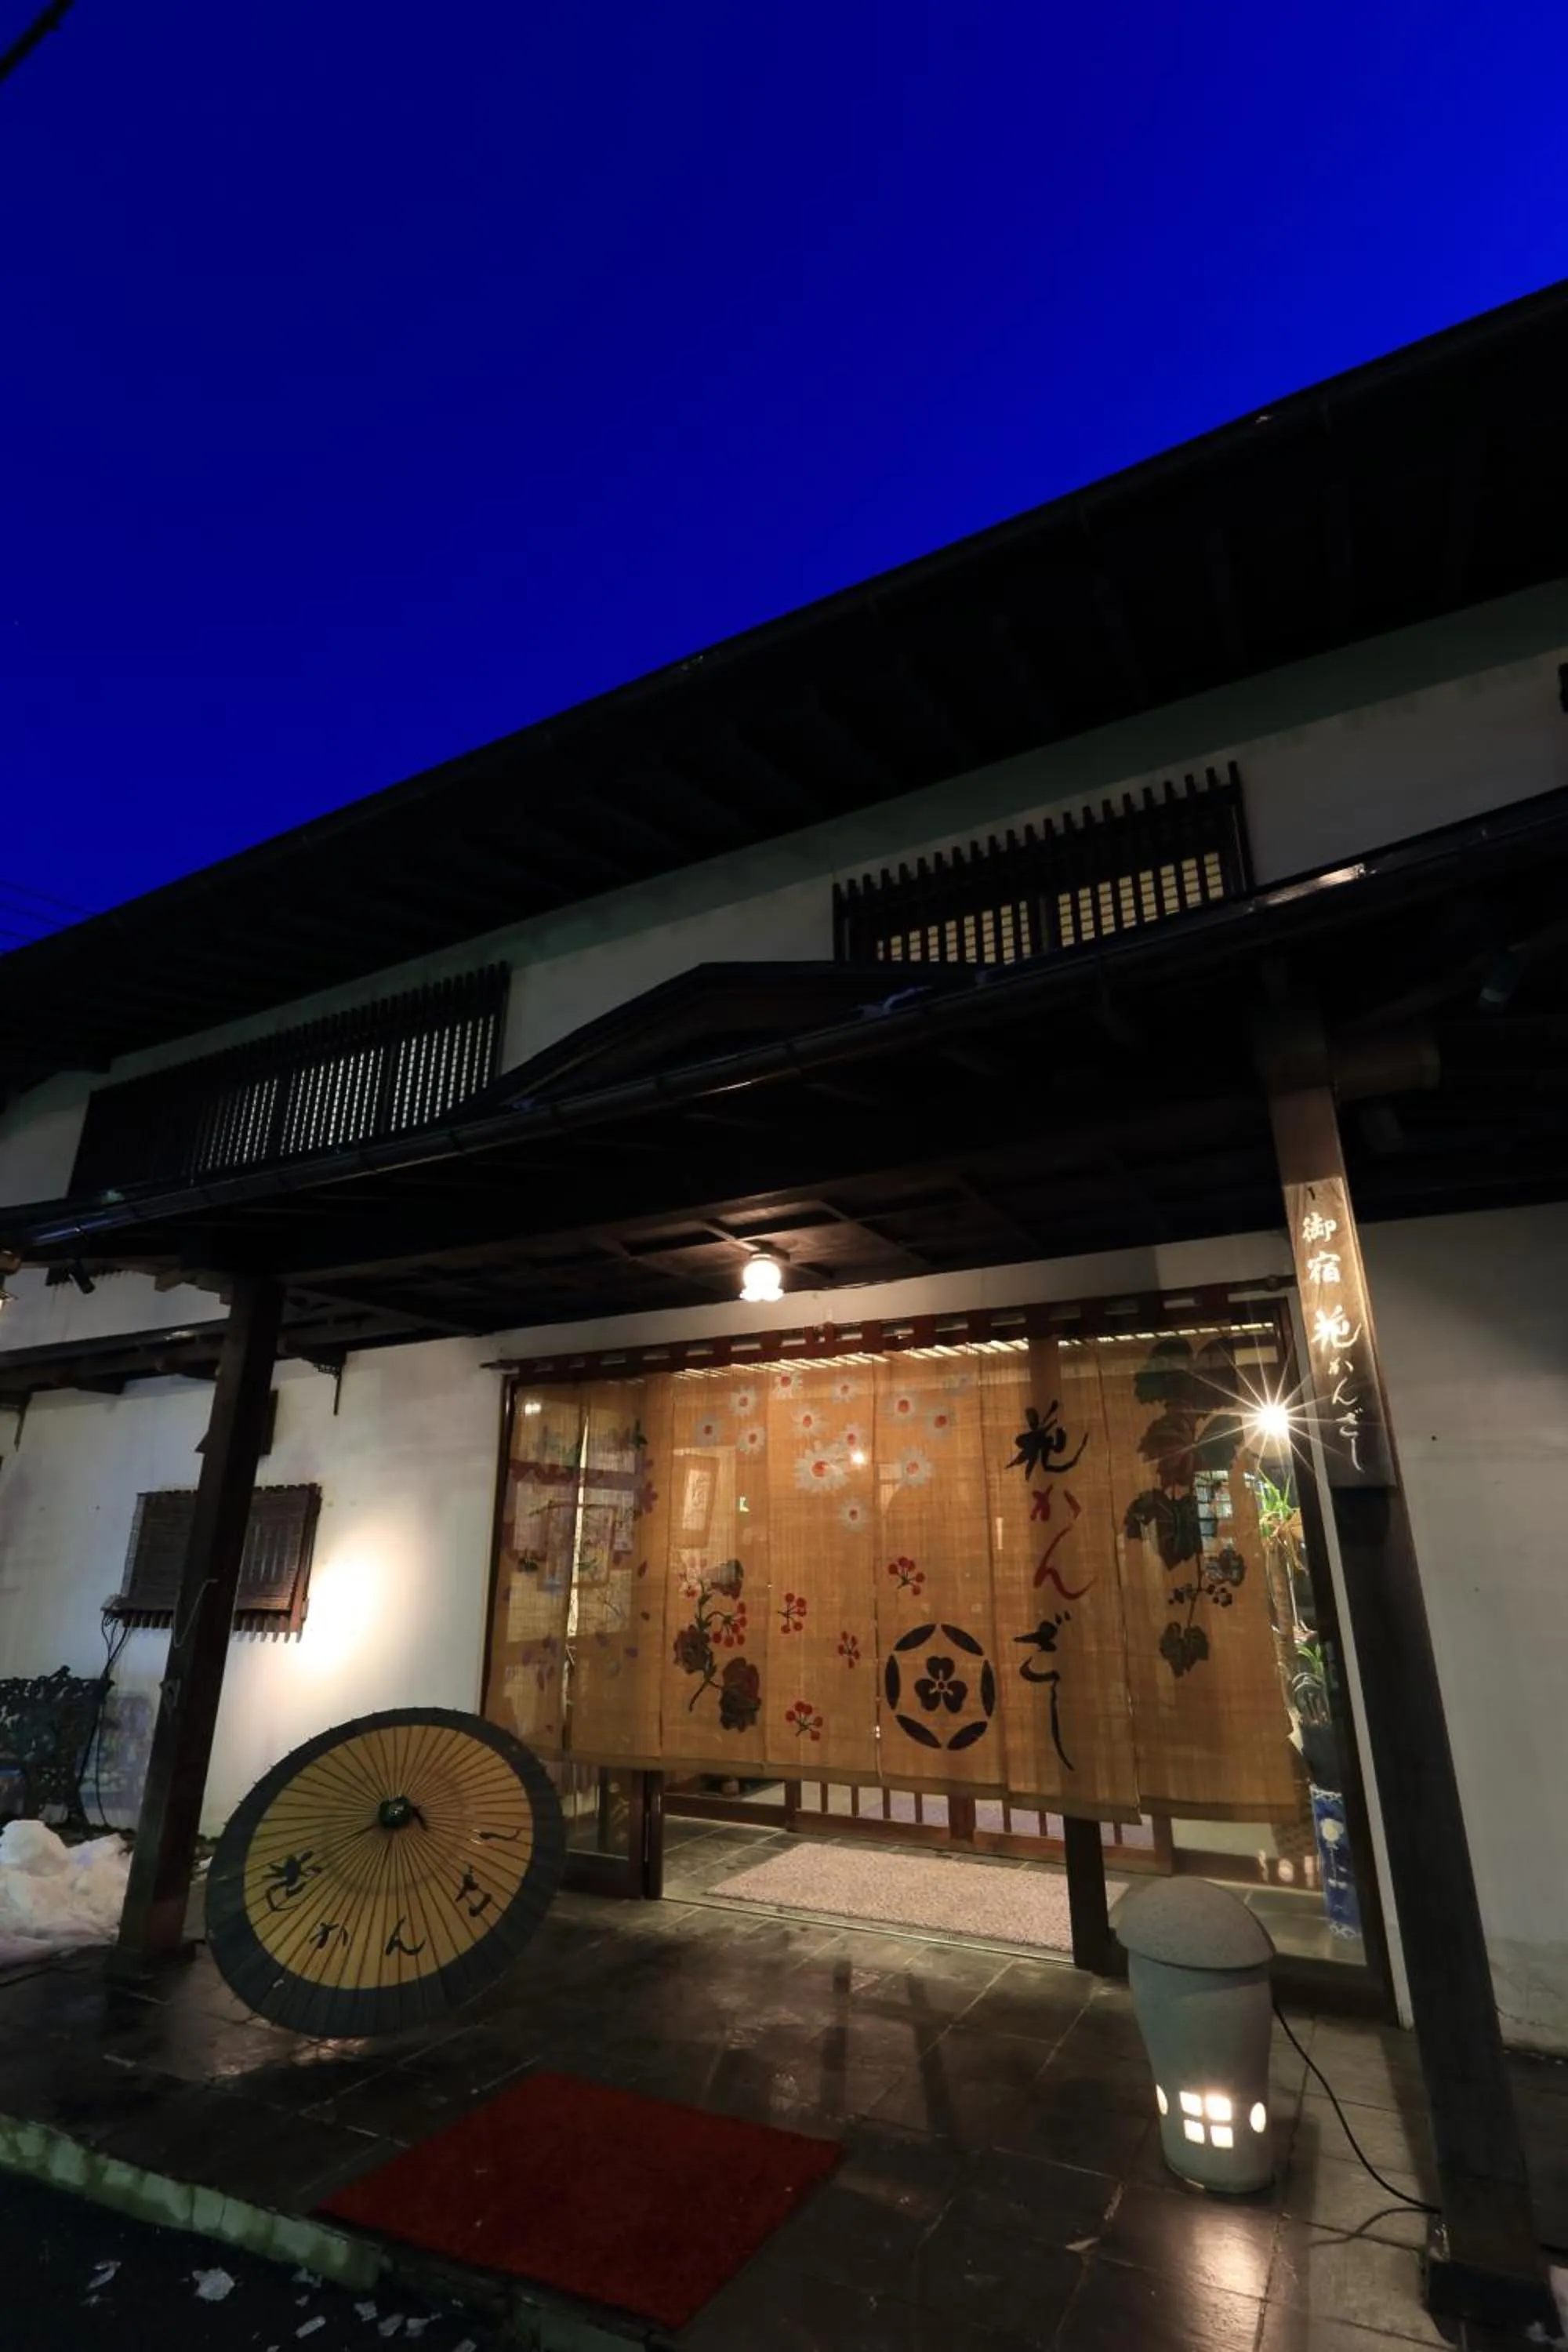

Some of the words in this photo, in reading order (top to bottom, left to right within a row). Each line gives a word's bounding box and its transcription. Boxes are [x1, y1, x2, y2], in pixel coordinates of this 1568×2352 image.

[1005, 1400, 1094, 1771] 花かんざし
